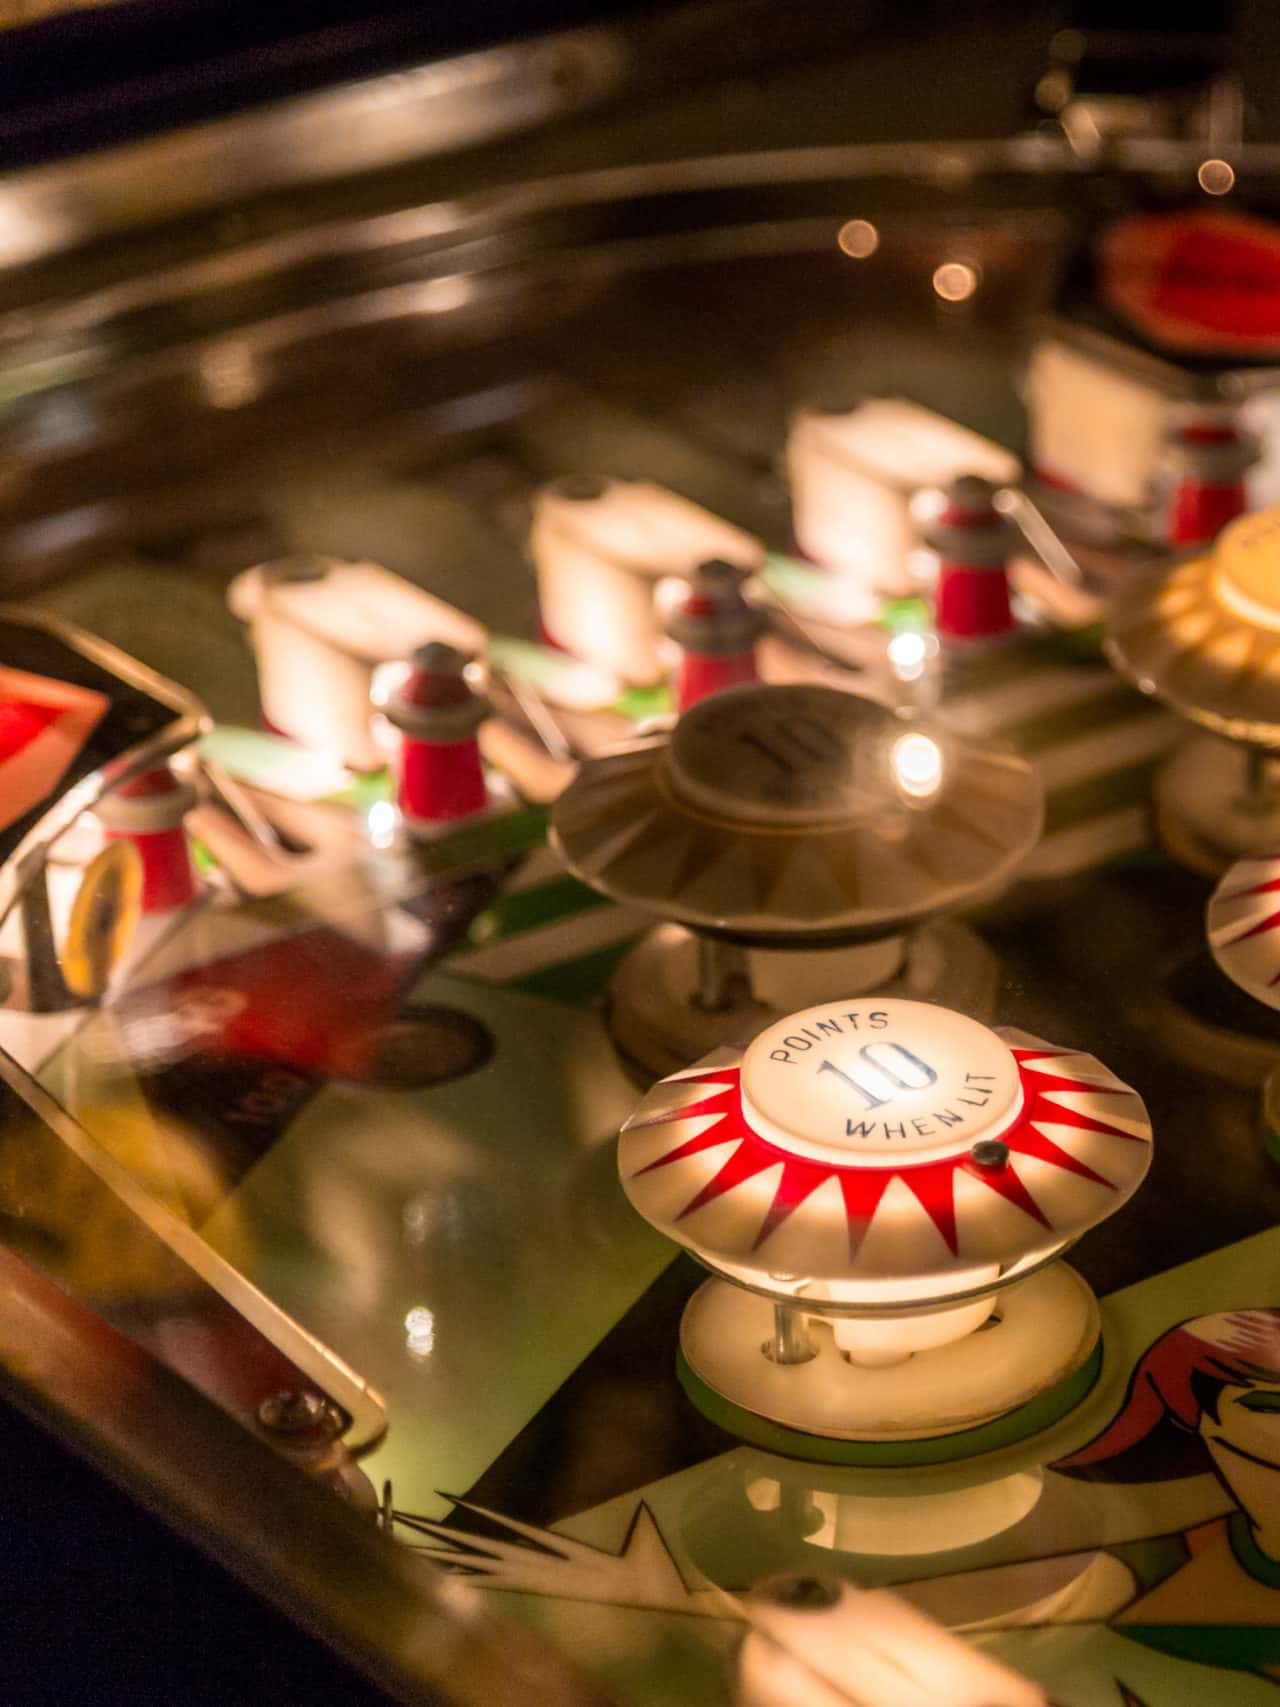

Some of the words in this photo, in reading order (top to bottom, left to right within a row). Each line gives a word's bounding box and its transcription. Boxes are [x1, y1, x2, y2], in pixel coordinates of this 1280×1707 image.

[769, 1011, 889, 1065] POINTS
[815, 1040, 938, 1112] 10
[846, 1108, 965, 1140] WHEN
[957, 1072, 998, 1108] LIT
